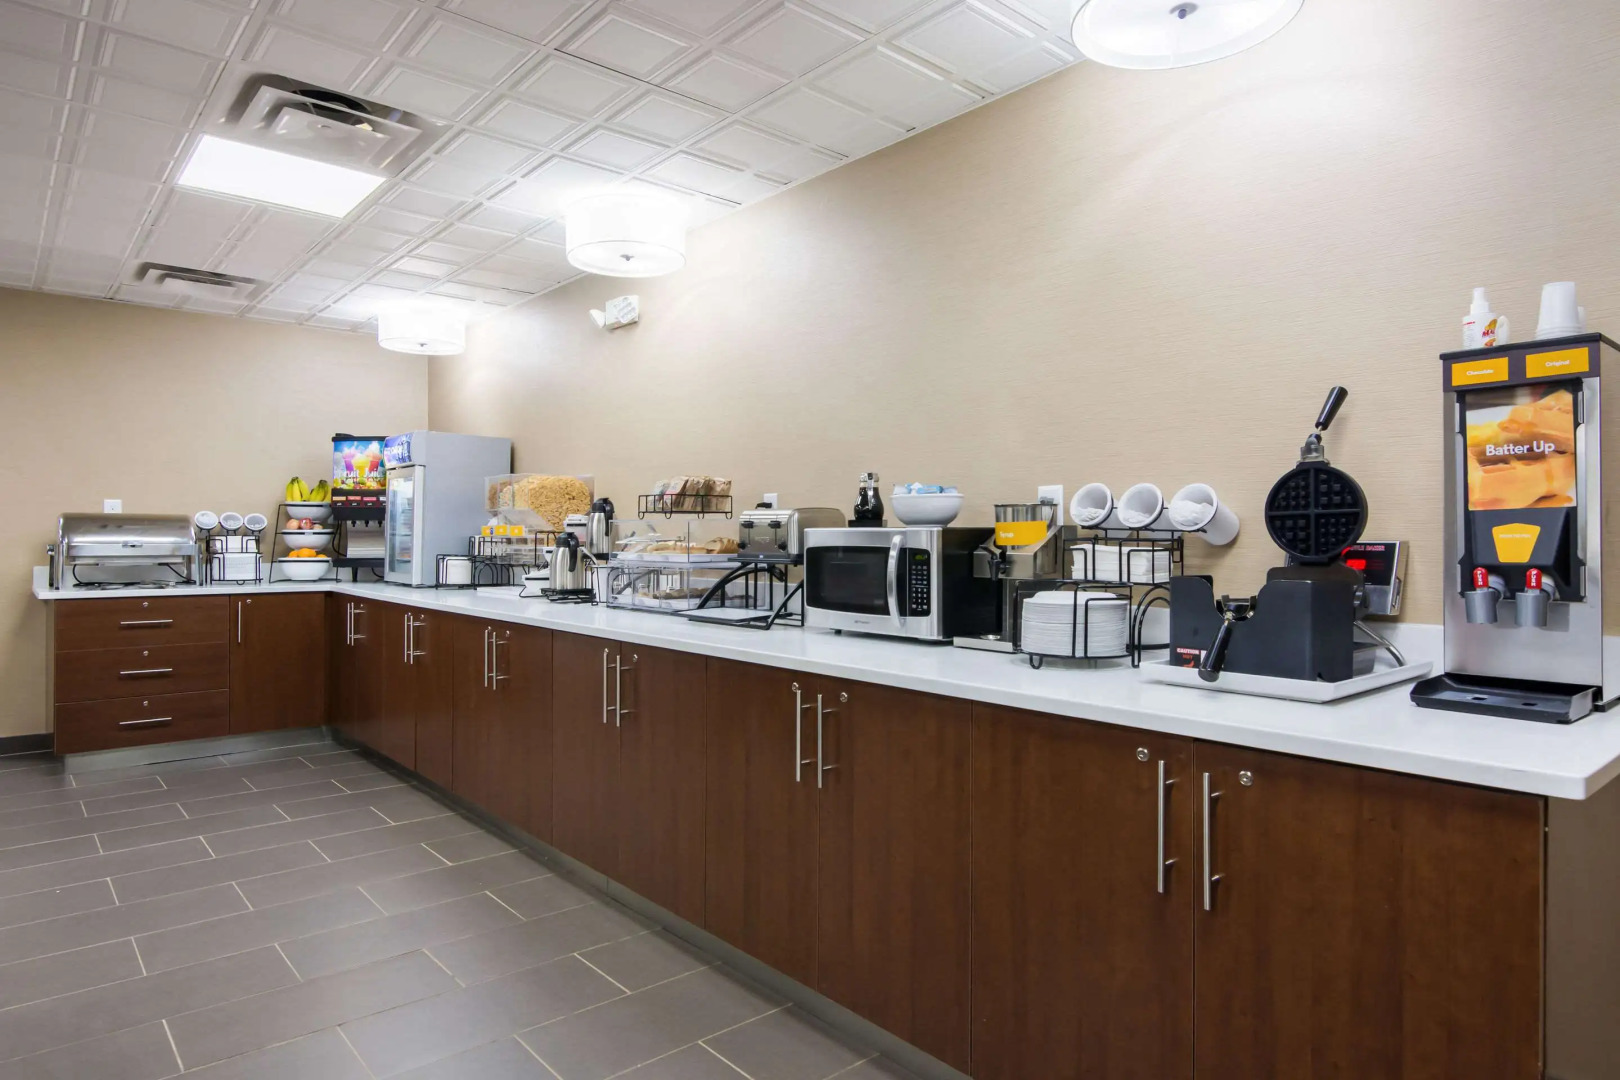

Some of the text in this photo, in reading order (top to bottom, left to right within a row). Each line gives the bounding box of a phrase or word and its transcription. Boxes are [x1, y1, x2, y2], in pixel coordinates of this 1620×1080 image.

[1486, 440, 1555, 456] Batter Up
[1176, 647, 1200, 655] CAUTION
